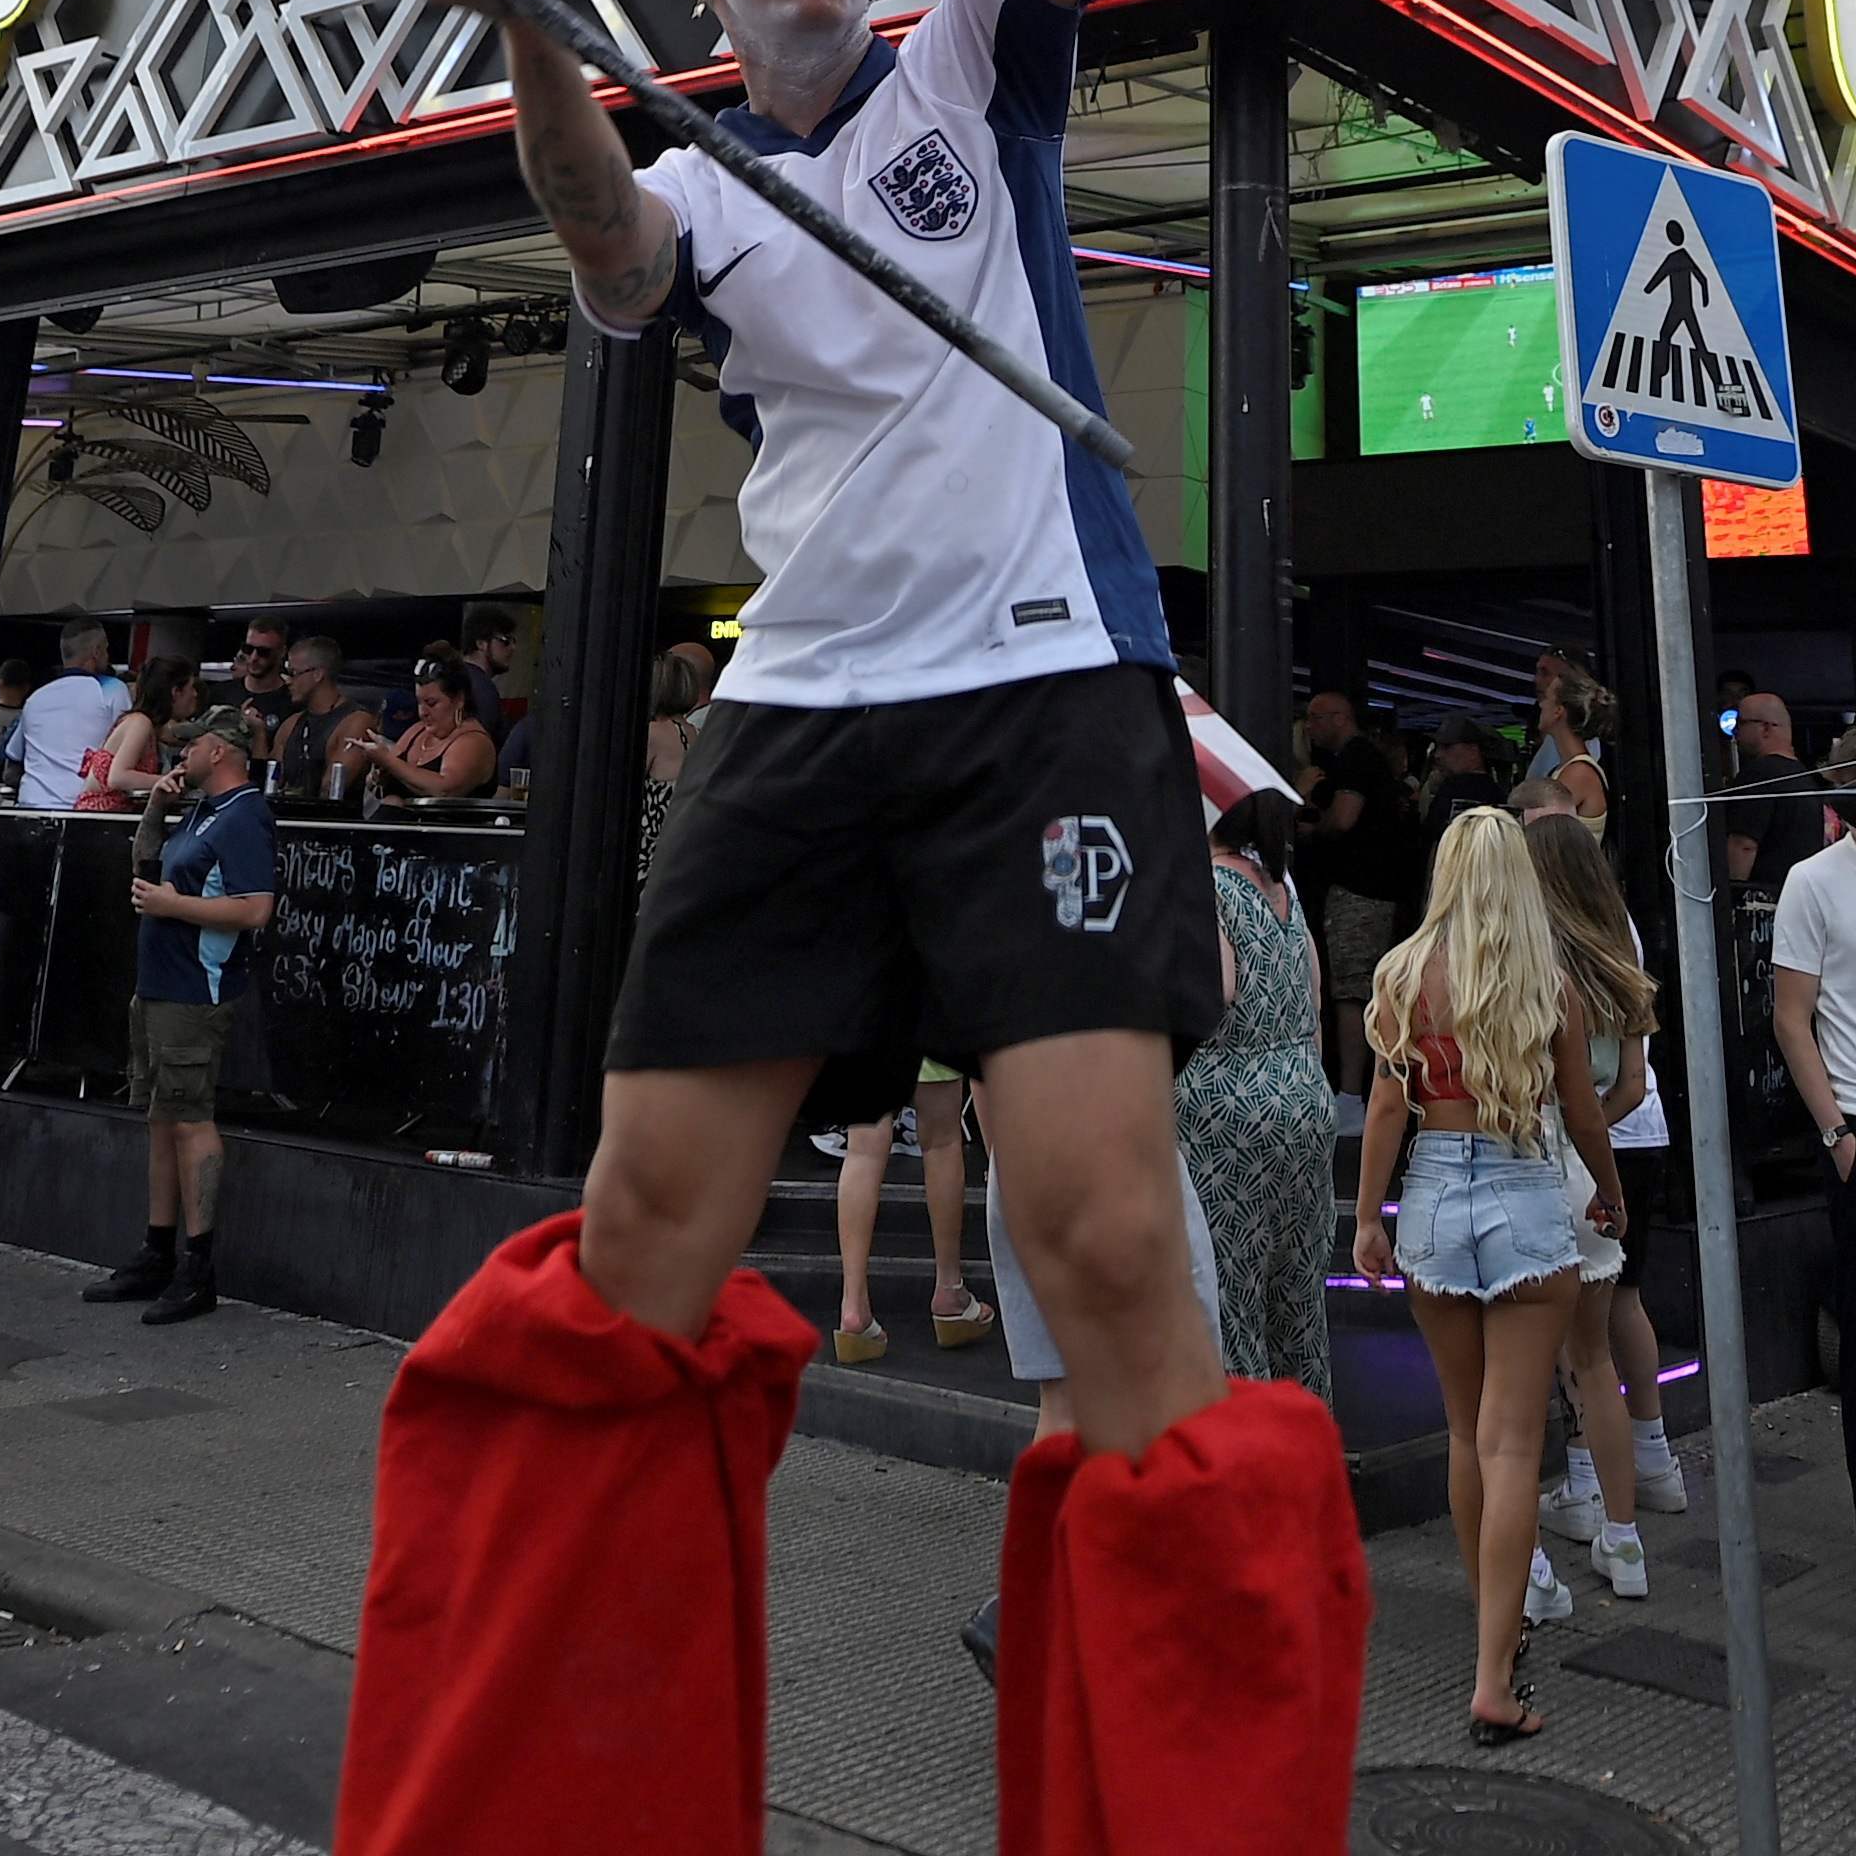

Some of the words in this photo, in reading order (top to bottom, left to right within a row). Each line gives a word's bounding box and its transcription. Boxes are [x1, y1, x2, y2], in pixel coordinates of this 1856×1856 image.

[276, 894, 325, 957] Sexy
[404, 897, 473, 970] Show
[431, 980, 487, 1031] 1:30
